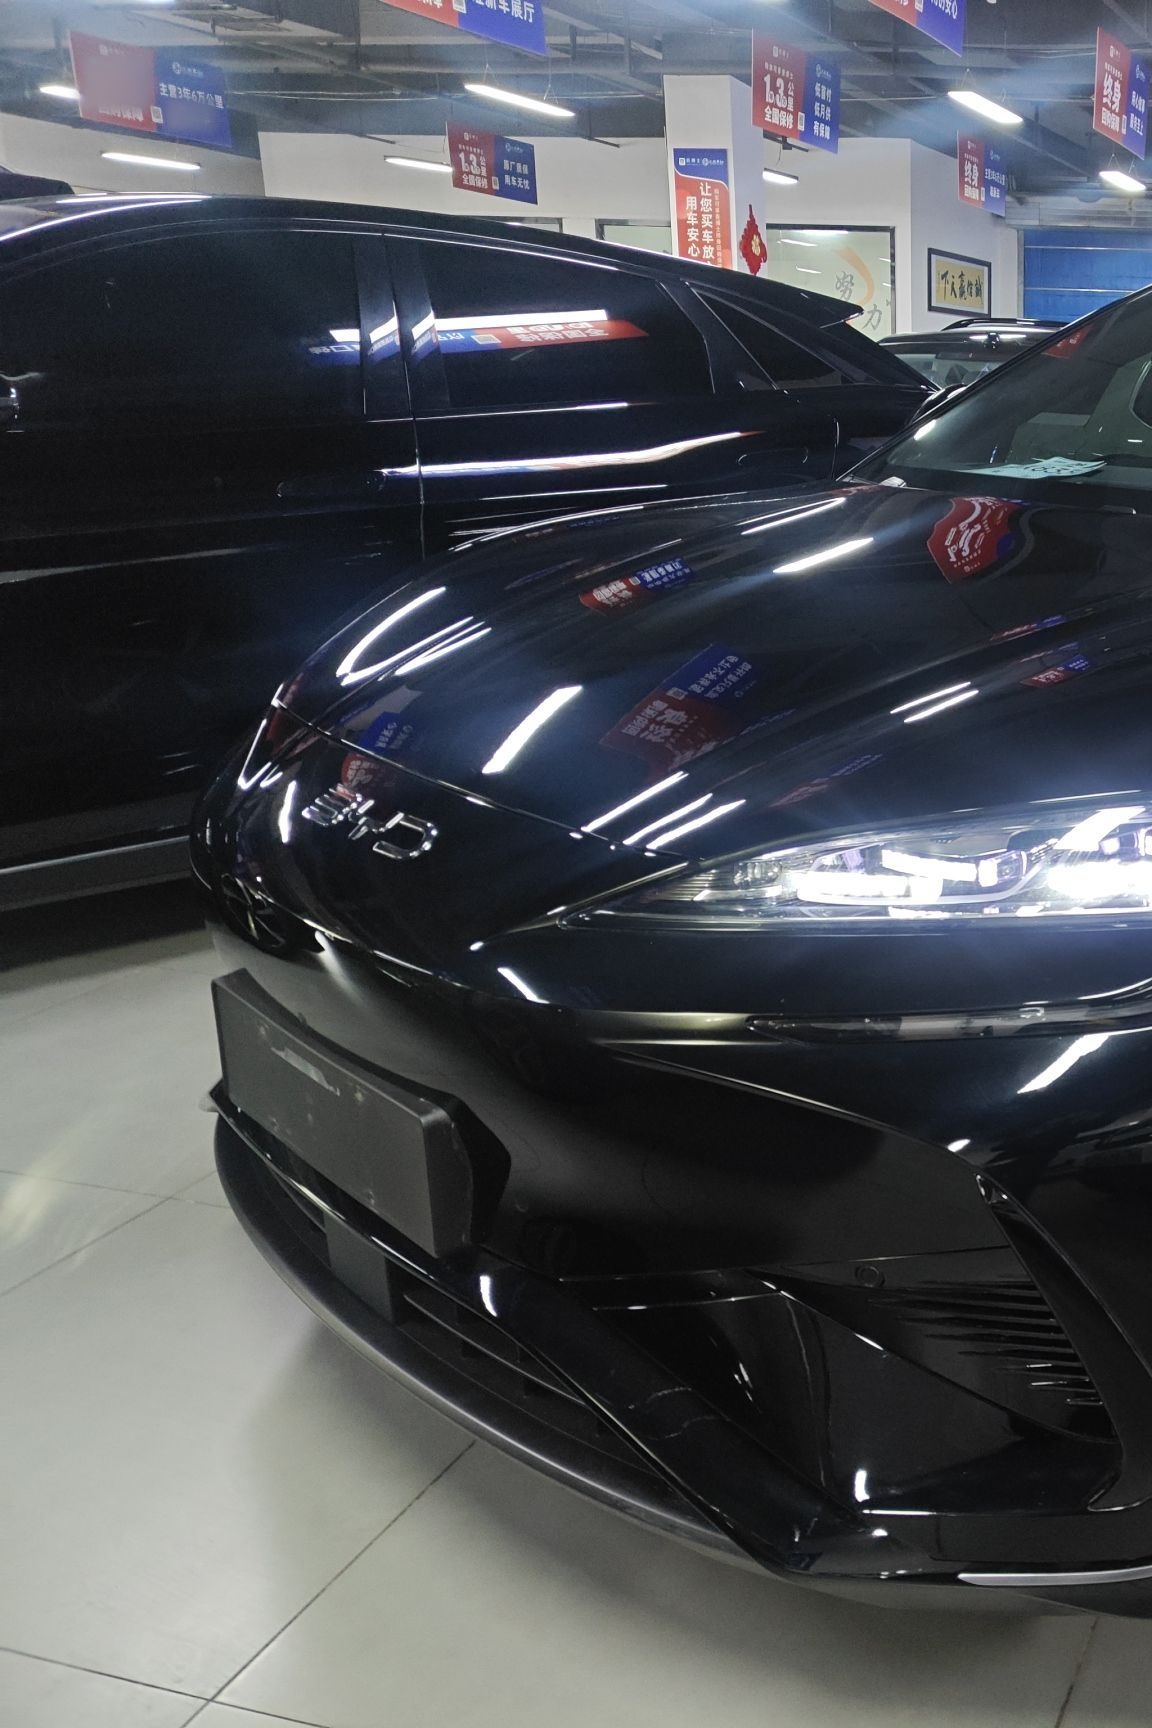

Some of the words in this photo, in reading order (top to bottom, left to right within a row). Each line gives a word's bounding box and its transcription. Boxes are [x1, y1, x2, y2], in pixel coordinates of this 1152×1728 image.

[472, 0, 535, 23] 新车展厅
[159, 83, 224, 109] 主营3年6万公里
[1103, 72, 1121, 113] 终身
[764, 105, 794, 129] 全国保修
[813, 120, 831, 140] 有保障
[462, 173, 488, 190] 全国保修
[686, 195, 700, 257] 用车安心
[699, 182, 715, 265] 让您买车放
[301, 783, 438, 860] BYD
